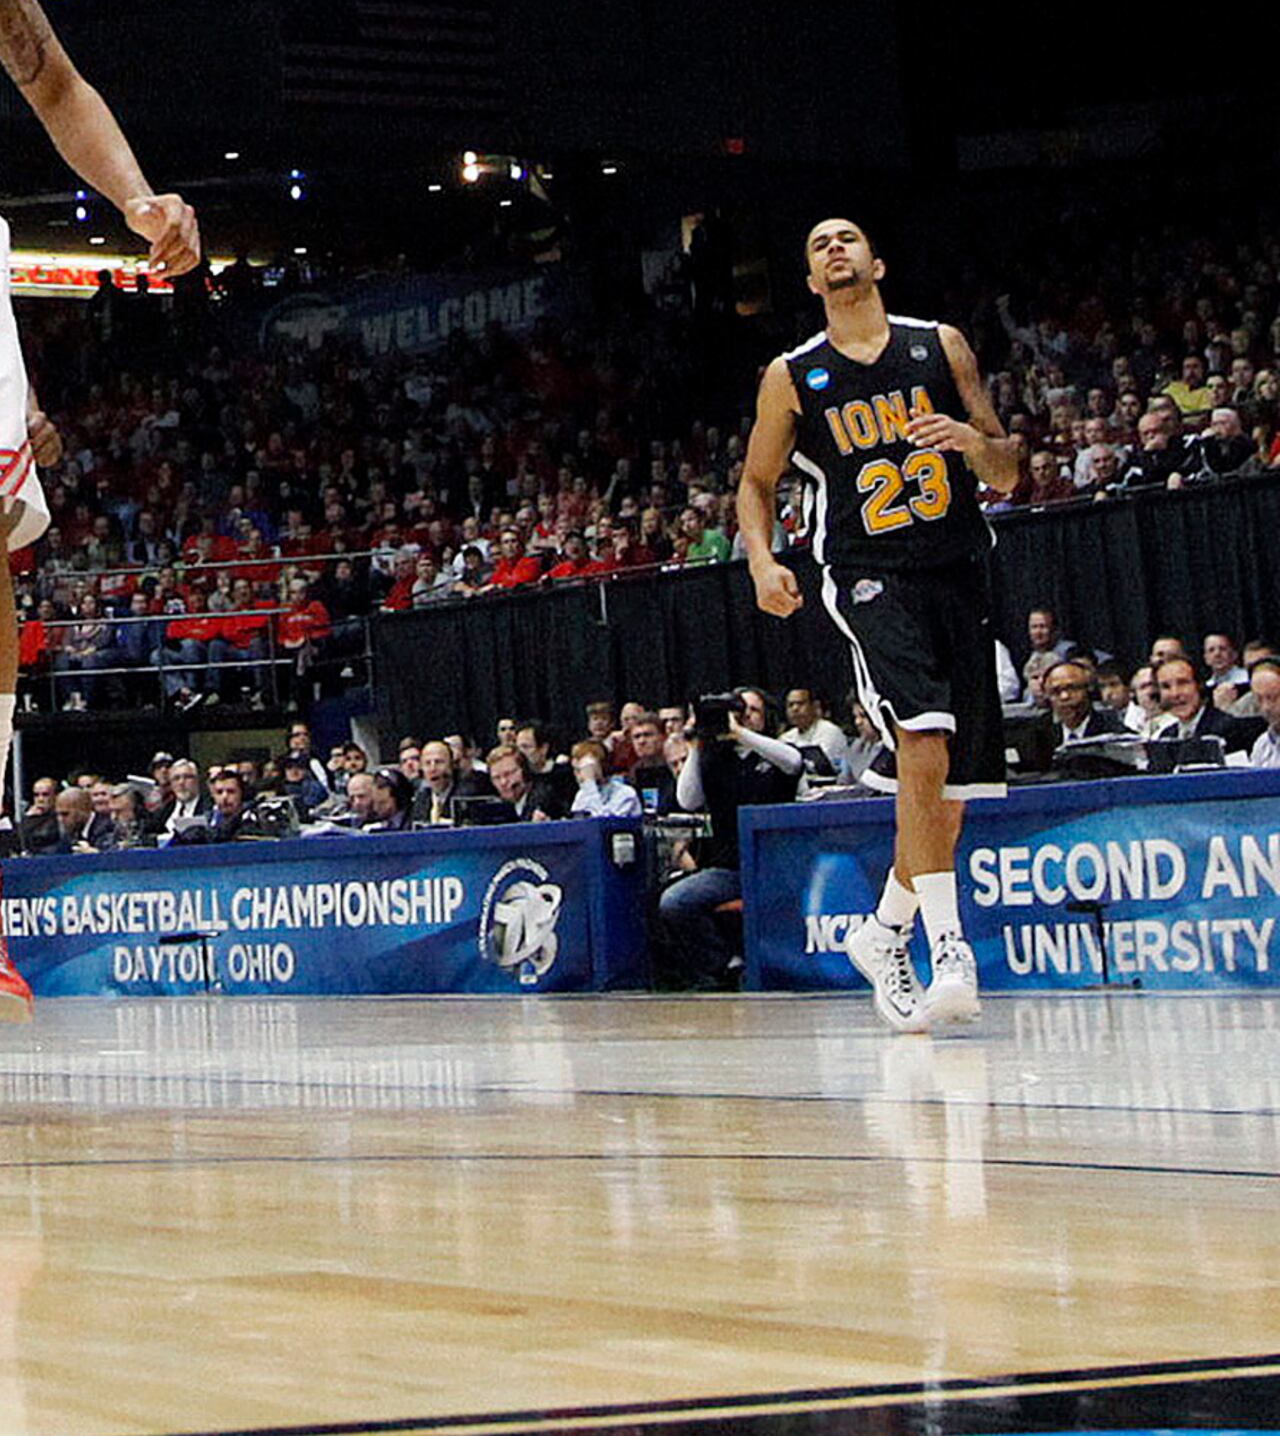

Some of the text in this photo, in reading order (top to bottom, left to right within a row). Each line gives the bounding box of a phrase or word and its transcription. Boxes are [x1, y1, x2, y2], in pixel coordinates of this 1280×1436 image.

[360, 278, 545, 354] WELCOME
[856, 447, 952, 537] 23
[968, 837, 1187, 908] SECOND
[61, 886, 229, 935] BASKETBALL
[231, 876, 465, 930] CHAMPIONSHIP
[227, 943, 295, 983] OHIO
[1003, 918, 1278, 976] UNIVERSITY
